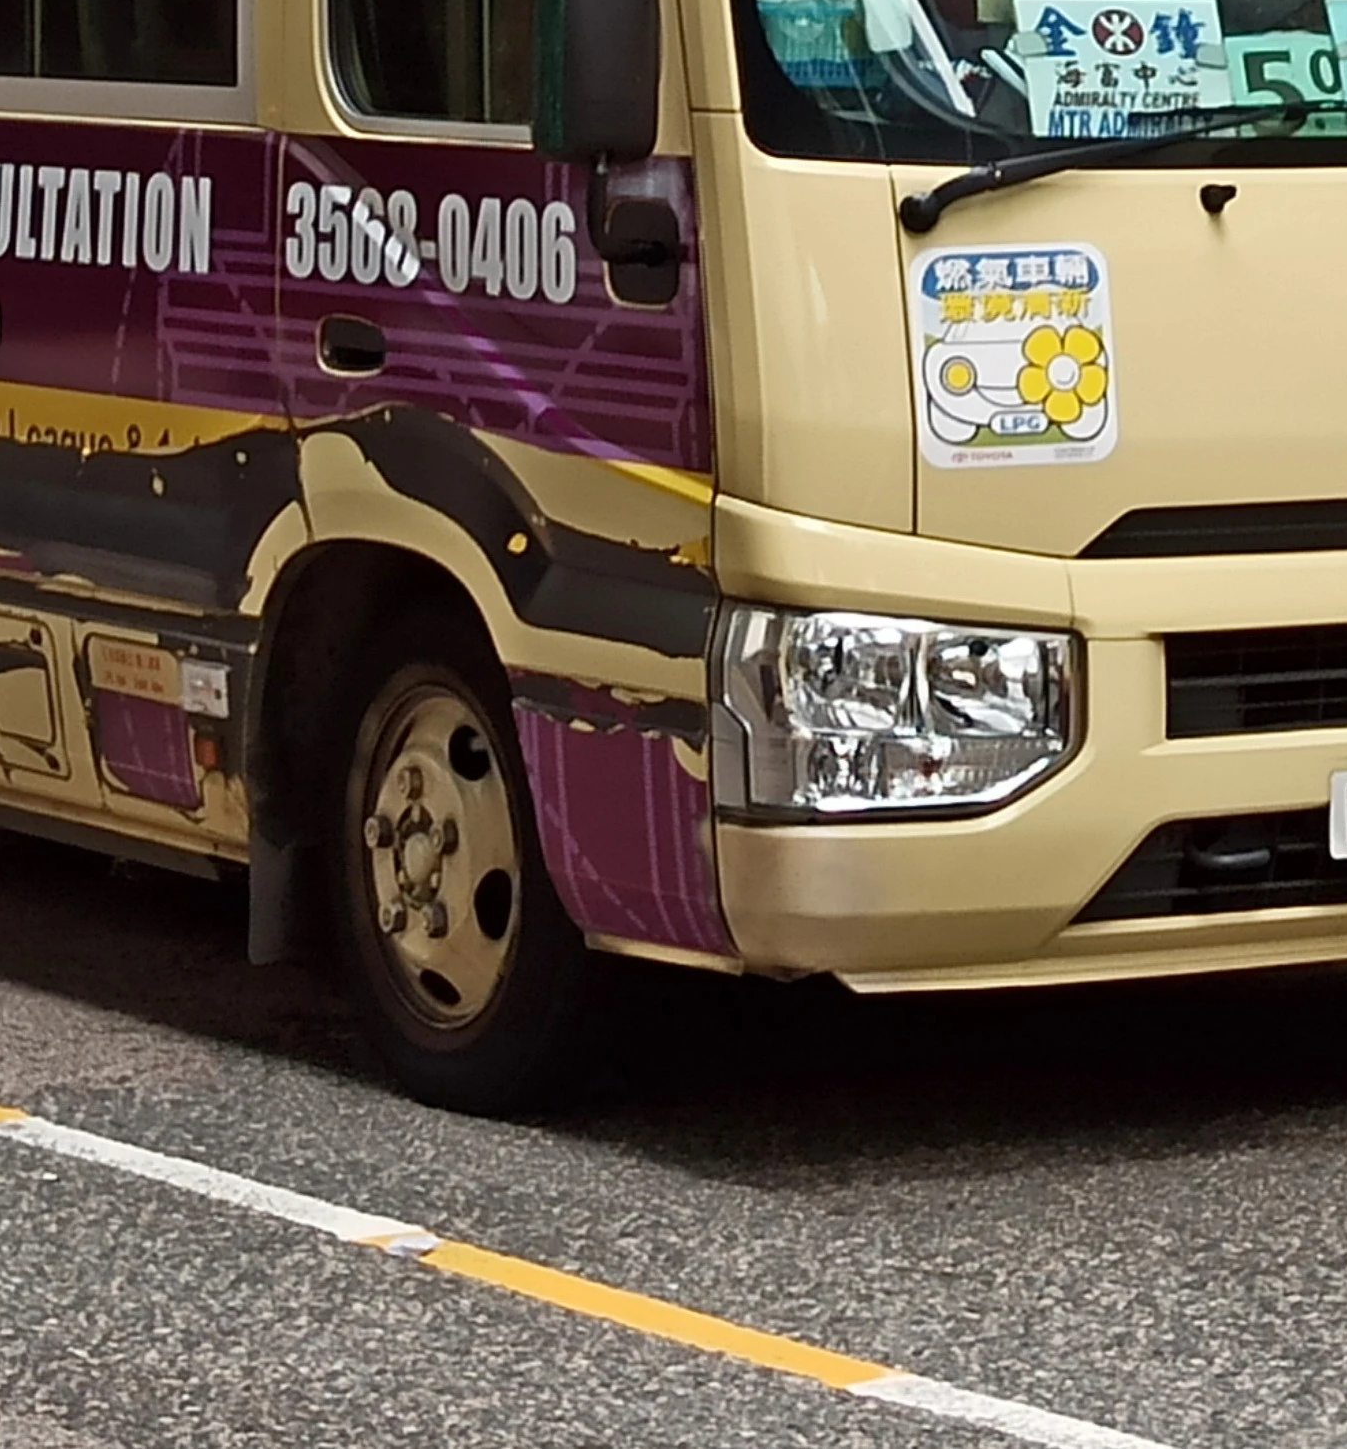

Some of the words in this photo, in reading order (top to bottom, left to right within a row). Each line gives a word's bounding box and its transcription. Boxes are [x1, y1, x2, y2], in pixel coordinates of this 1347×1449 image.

[1054, 90, 1137, 108] ADMIRALTY
[1141, 92, 1200, 111] CENTRE
[1047, 109, 1092, 139] MTR
[286, 181, 577, 305] 3568-0406
[1000, 415, 1042, 432] LPG
